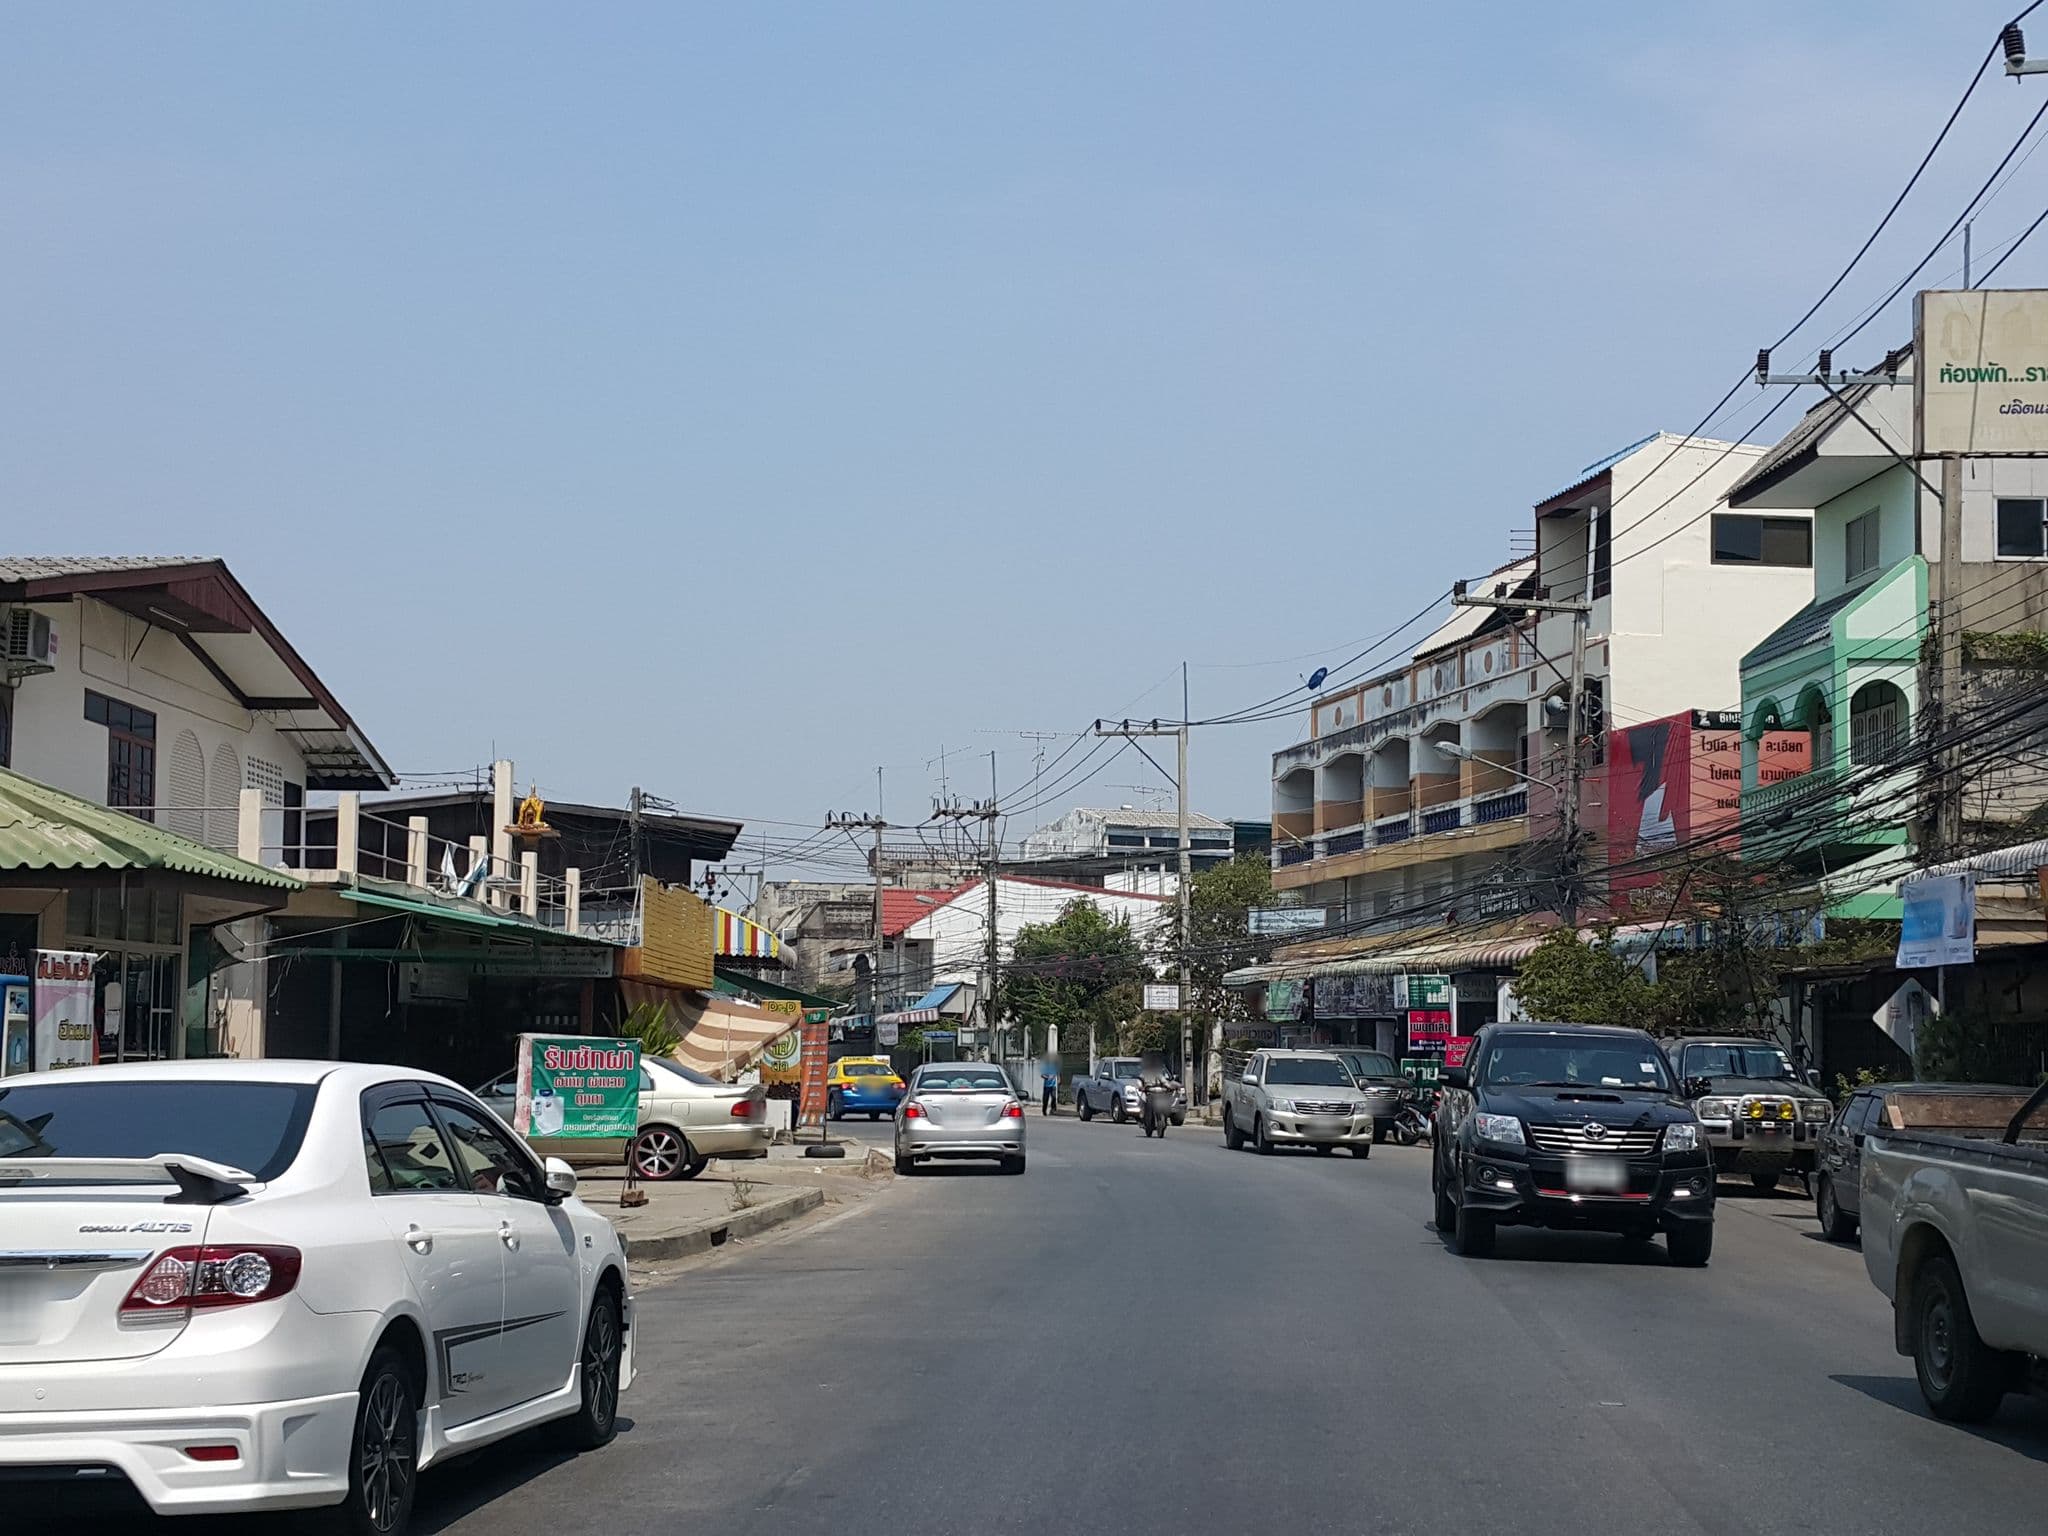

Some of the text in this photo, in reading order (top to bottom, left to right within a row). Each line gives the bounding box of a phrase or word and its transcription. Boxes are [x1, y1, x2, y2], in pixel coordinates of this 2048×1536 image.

[1939, 362, 2048, 383] ห้องพัก...รา
[544, 1041, 635, 1071] รับซักผ้า
[79, 1222, 193, 1233] COROLLA ALTIS
